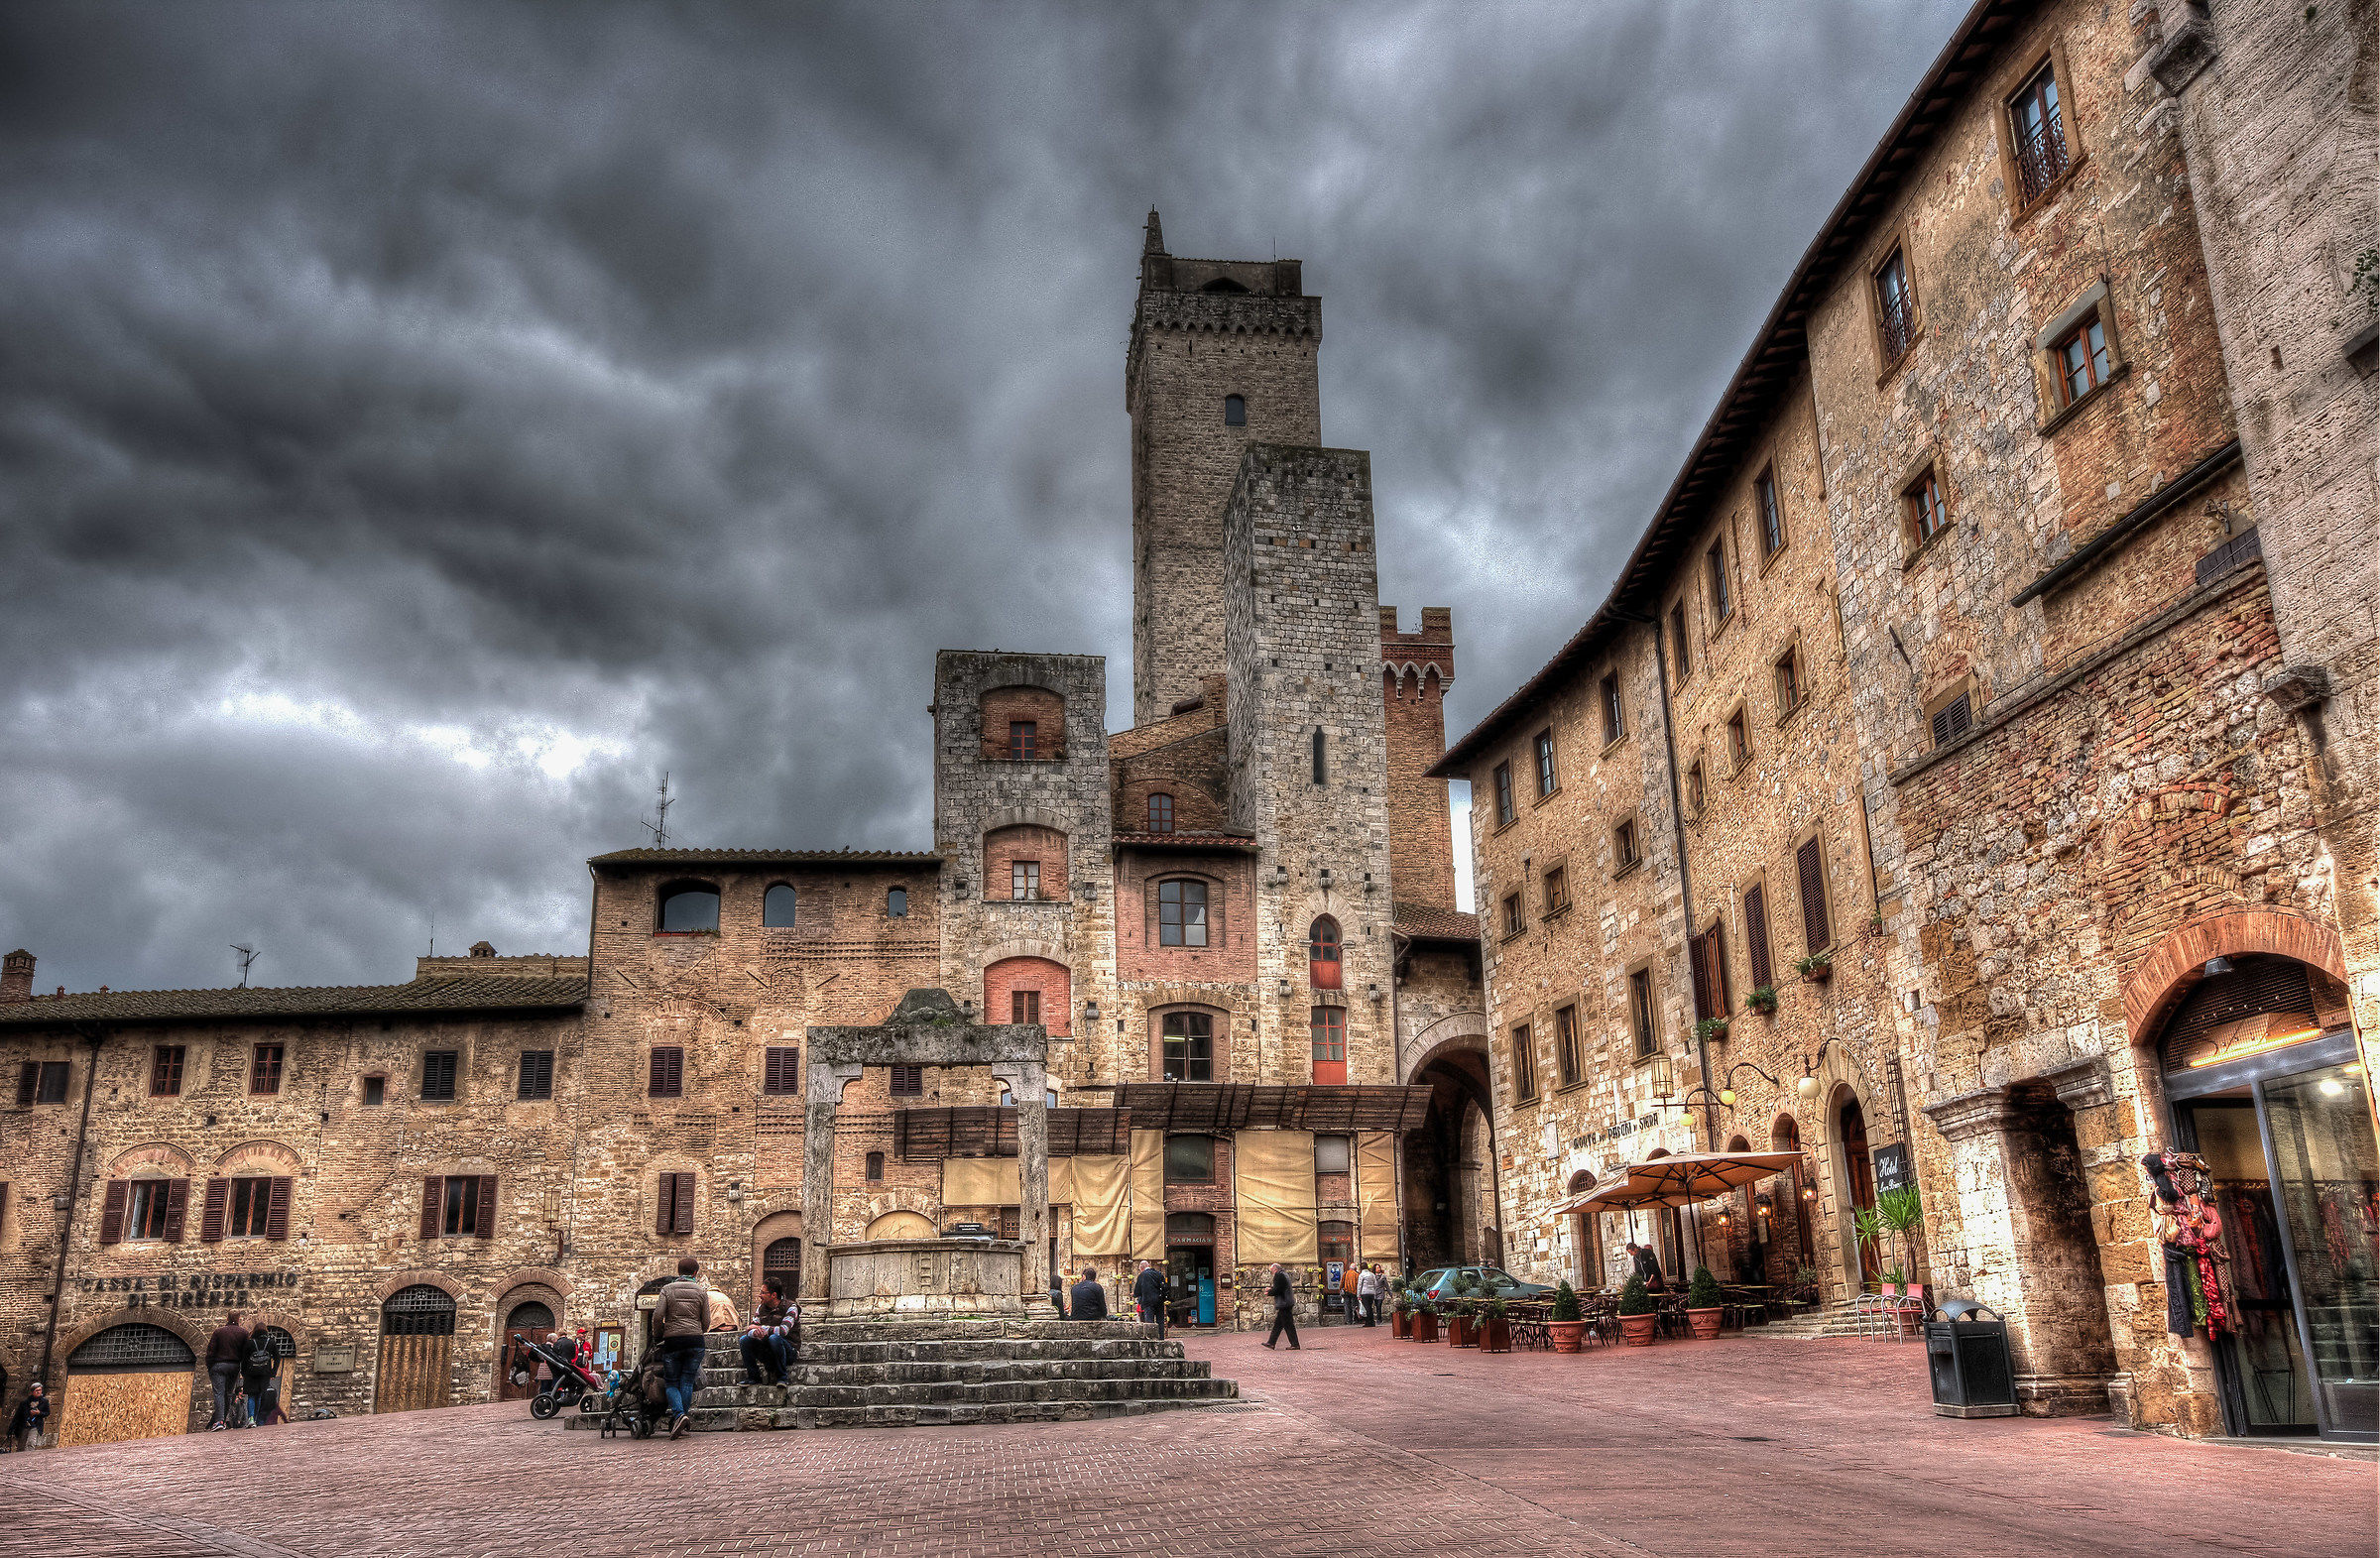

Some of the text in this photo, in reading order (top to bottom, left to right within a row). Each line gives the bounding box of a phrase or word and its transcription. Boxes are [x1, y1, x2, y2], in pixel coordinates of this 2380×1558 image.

[1878, 1155, 1899, 1178] Hotel
[81, 1272, 298, 1292] CASSA DI RISPARMIO
[128, 1291, 248, 1307] DI FIRENZE
